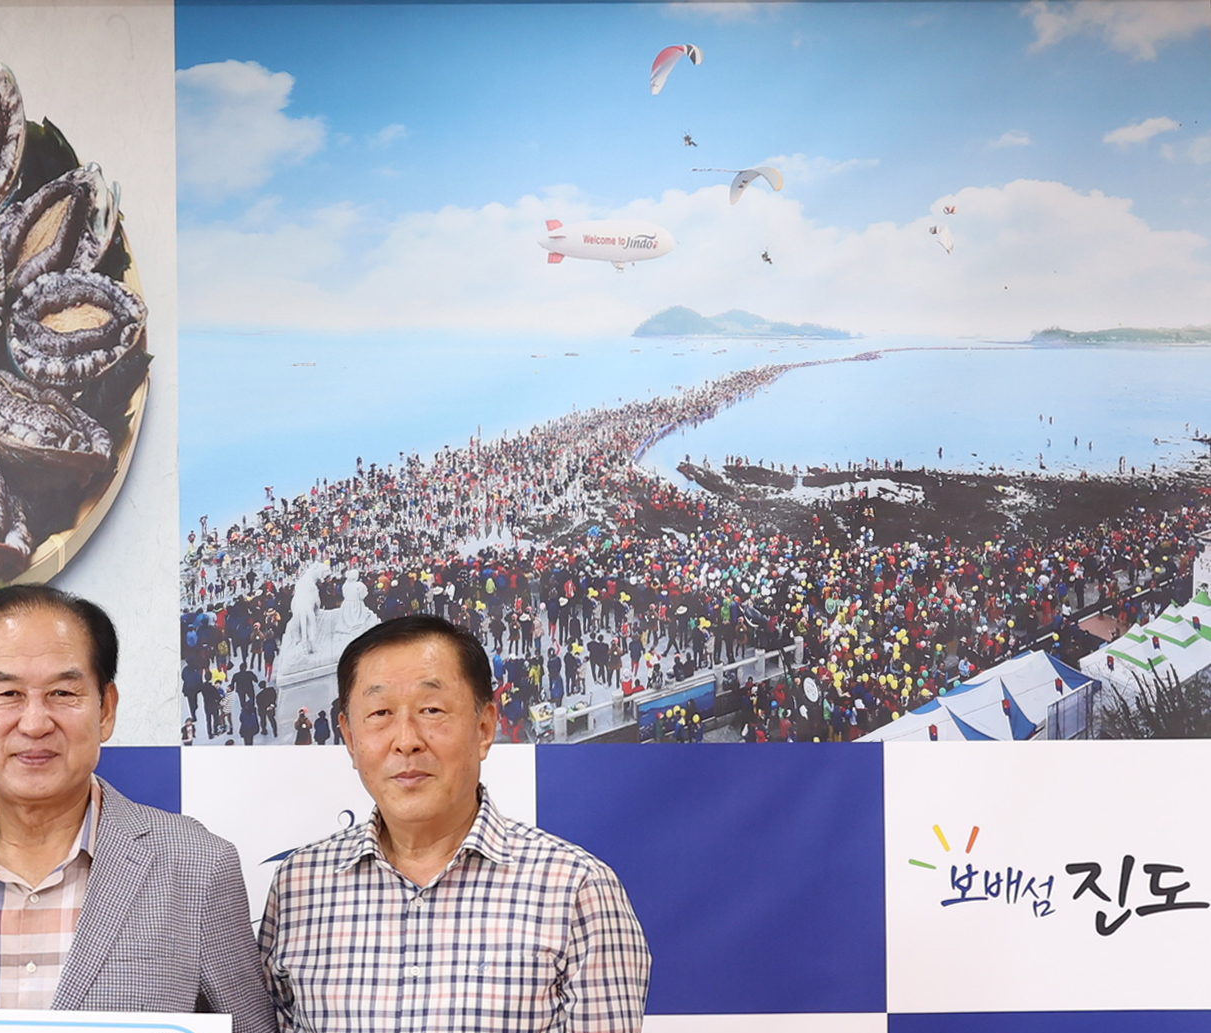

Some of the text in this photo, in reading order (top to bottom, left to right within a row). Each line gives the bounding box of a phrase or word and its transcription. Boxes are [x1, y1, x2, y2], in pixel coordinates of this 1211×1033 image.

[583, 234, 653, 250] Welcome to Jindo
[941, 854, 1210, 936] 보배섬 진도
